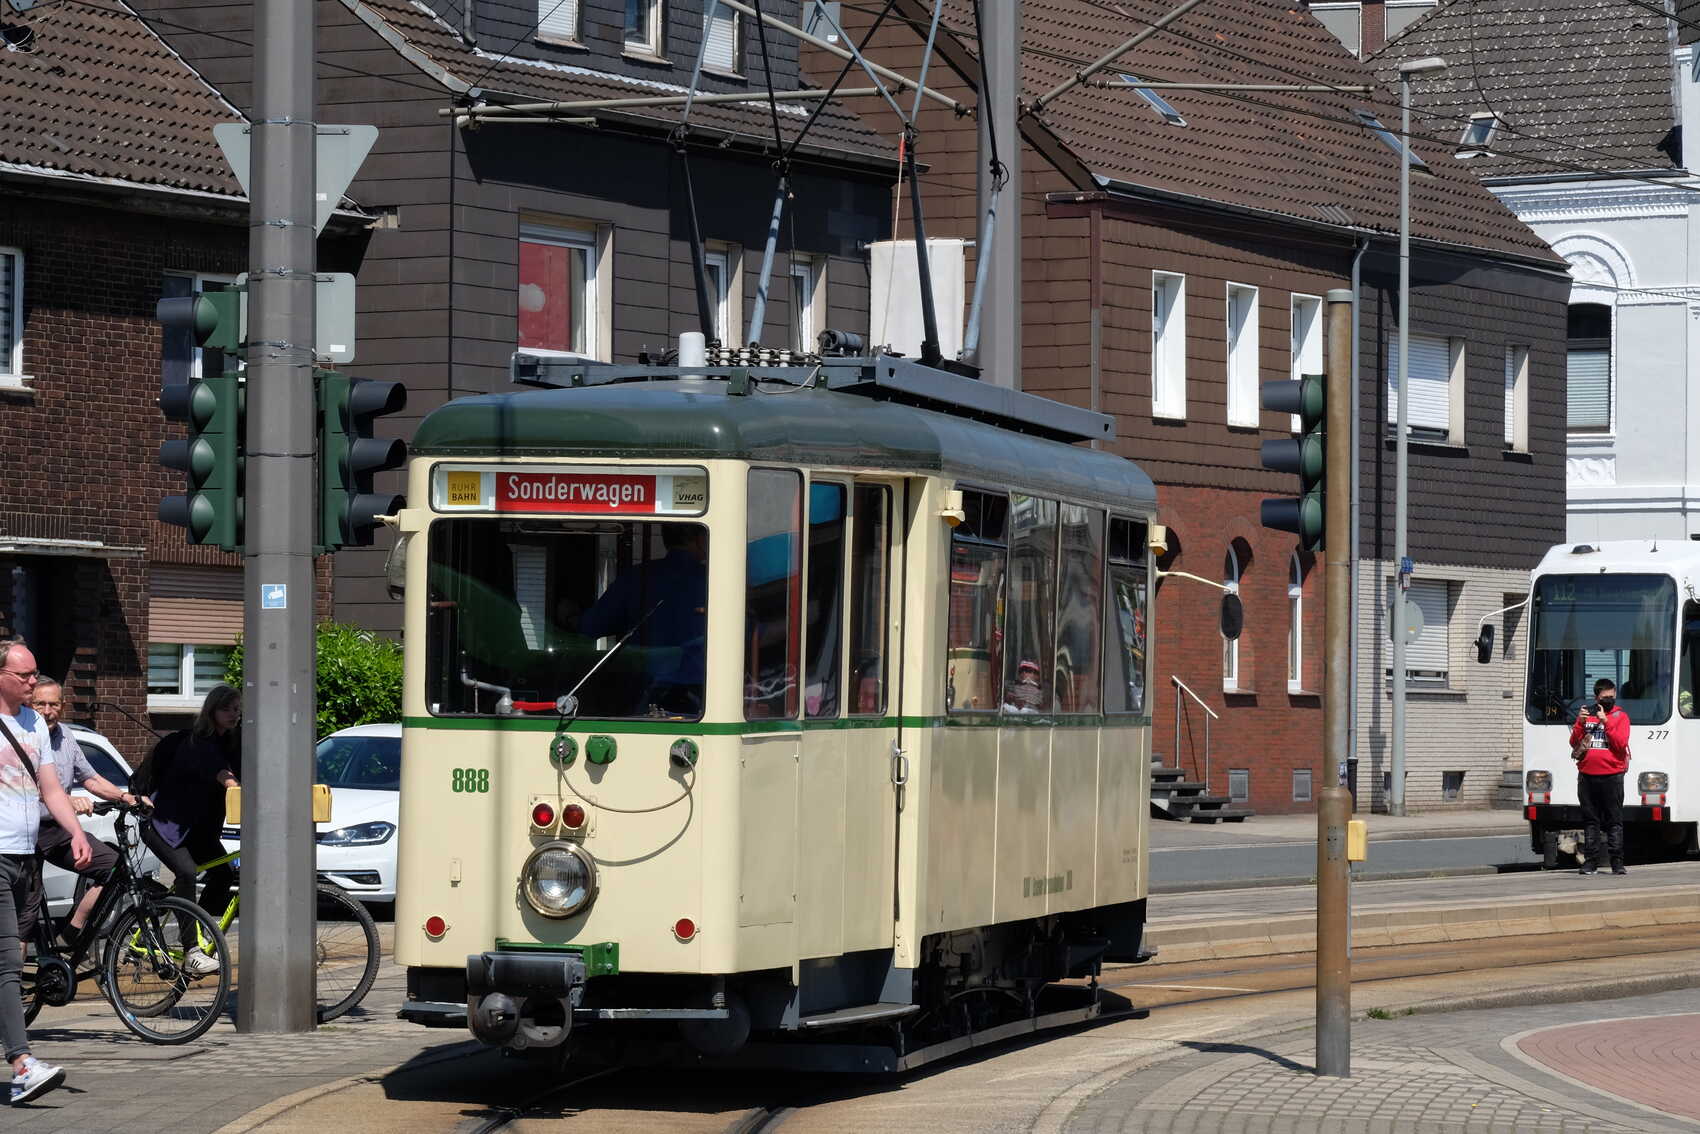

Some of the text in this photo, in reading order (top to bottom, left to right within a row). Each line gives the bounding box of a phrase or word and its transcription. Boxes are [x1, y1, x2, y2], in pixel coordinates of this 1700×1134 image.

[451, 482, 476, 492] RUHR
[507, 475, 645, 508] Sonderwagen
[451, 492, 477, 502] BAHN
[678, 493, 704, 502] VHAG
[1552, 583, 1576, 601] 112
[1646, 730, 1669, 741] 277
[452, 767, 490, 793] 888
